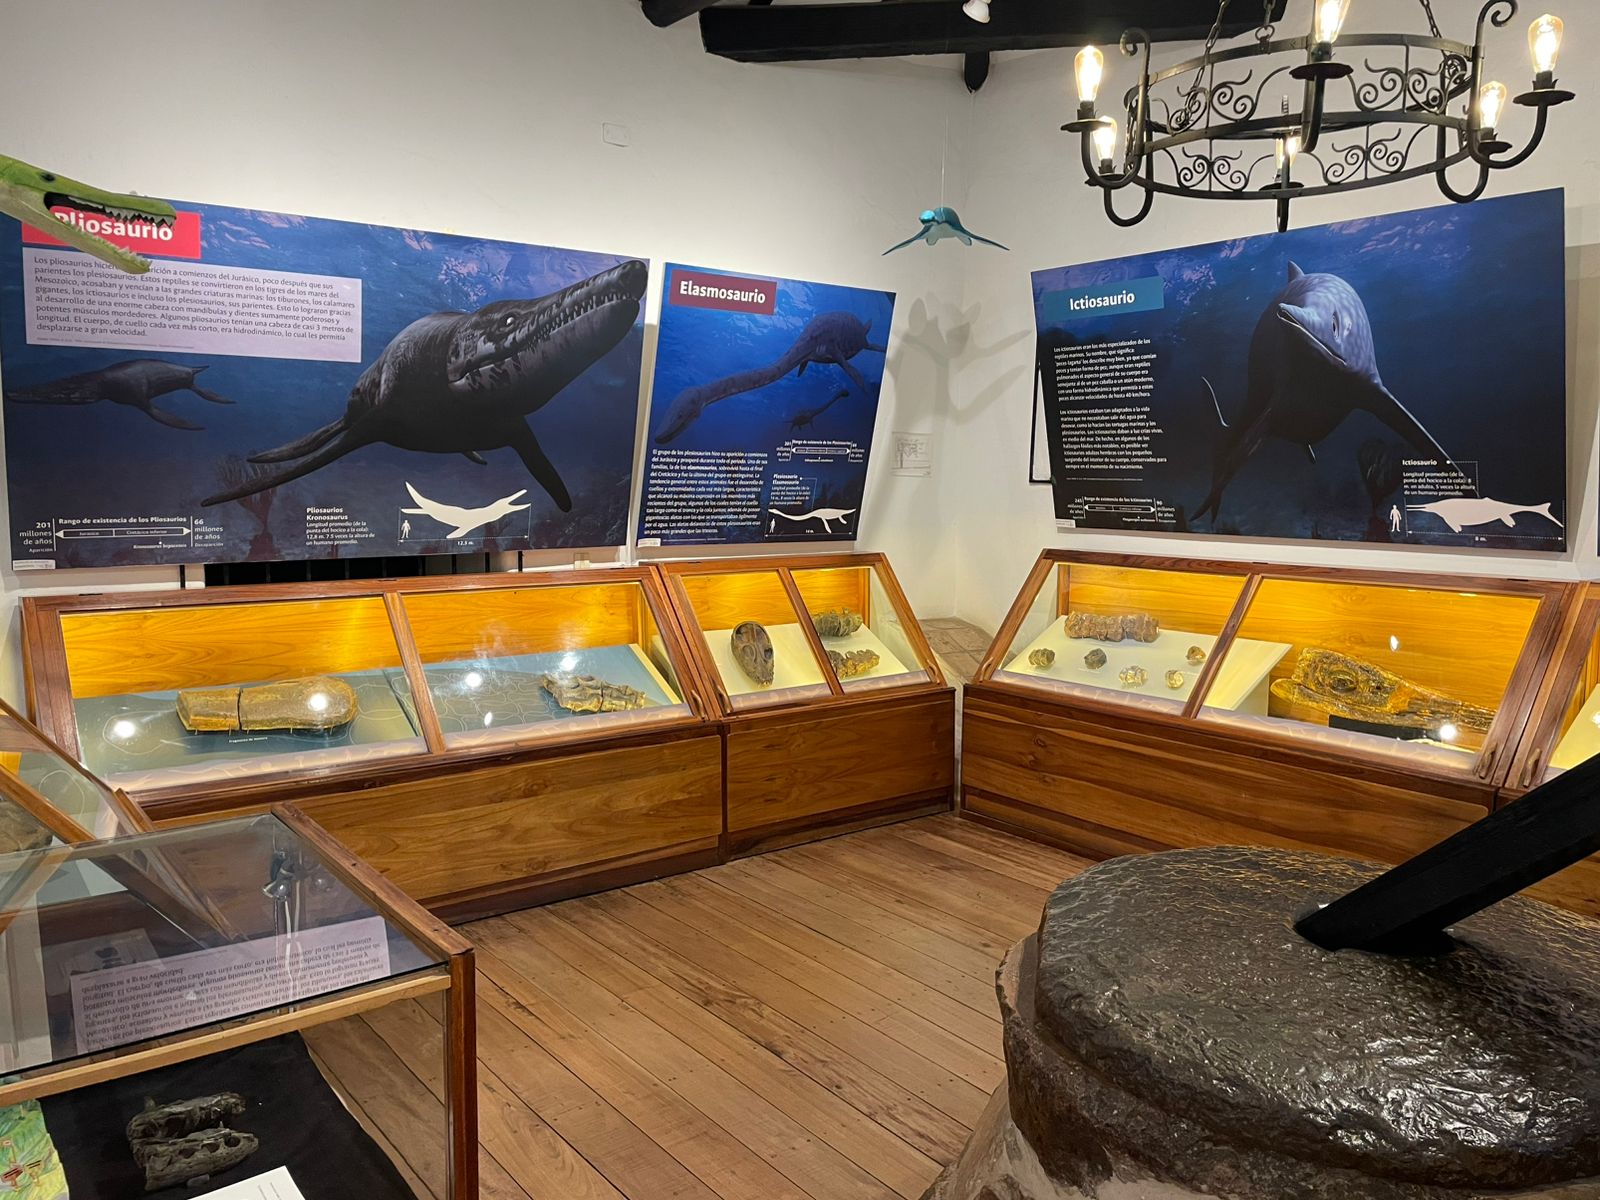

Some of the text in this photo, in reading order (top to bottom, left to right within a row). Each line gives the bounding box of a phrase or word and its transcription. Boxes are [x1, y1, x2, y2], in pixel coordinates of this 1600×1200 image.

[74, 269, 85, 277] los
[162, 278, 190, 286] reptiles
[267, 286, 285, 294] tigres
[81, 280, 117, 288] acosaban
[149, 267, 171, 275] rición
[281, 278, 307, 288] después
[680, 280, 766, 303] Elasmosaurio
[1070, 290, 1135, 310] Ictiosaurio
[138, 293, 164, 301] incluso
[301, 306, 328, 314] lograron
[235, 309, 260, 317] dientes
[73, 307, 109, 316] músculos
[160, 313, 190, 322] Algunos
[84, 318, 112, 326] cuerpo,
